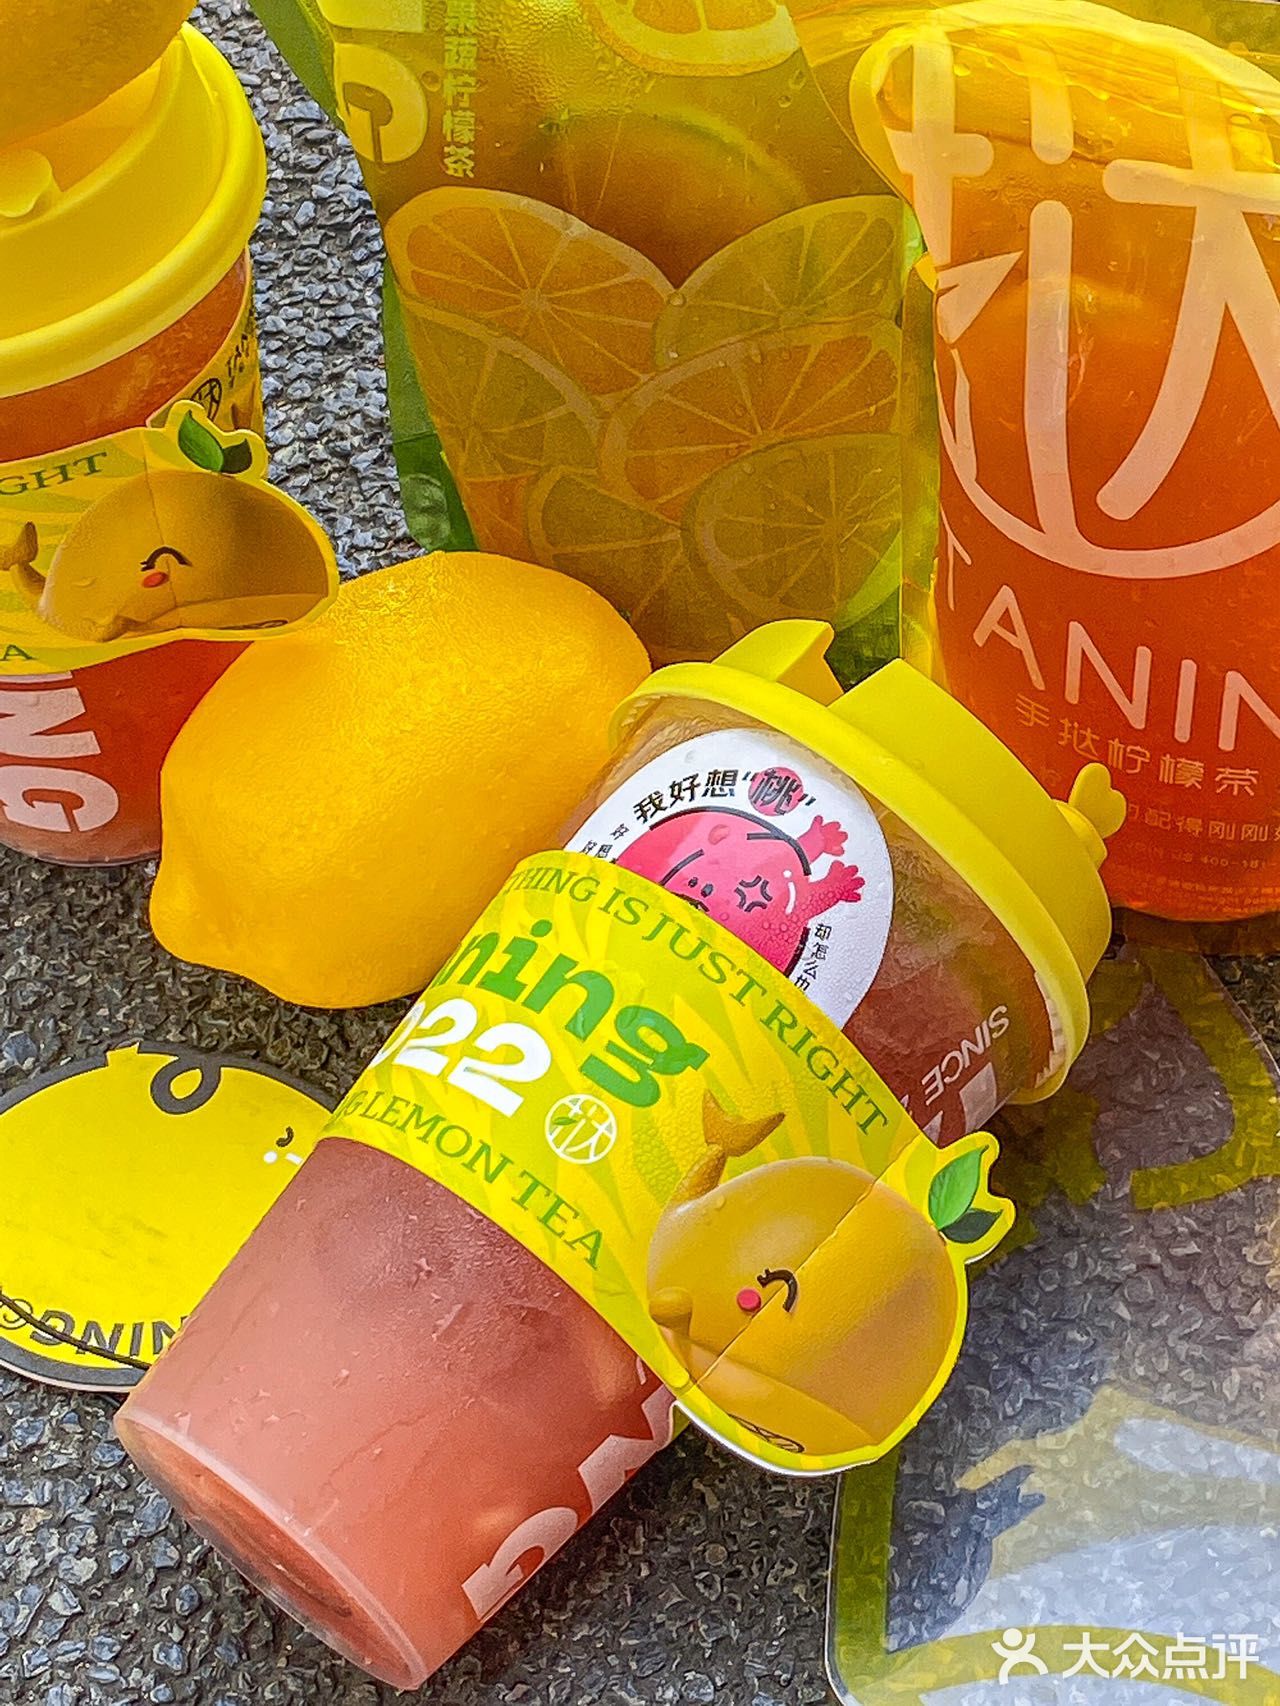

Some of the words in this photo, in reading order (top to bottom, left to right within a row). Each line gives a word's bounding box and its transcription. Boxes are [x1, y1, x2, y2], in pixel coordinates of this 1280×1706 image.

[1016, 693, 1259, 797] 手挞柠檬茶
[598, 887, 650, 926] IS
[642, 912, 768, 1007] JUST
[759, 999, 890, 1136] RIGHT
[921, 1004, 1010, 1106] SINCE
[359, 1091, 514, 1184] LEMON
[511, 1169, 605, 1271] TEA
